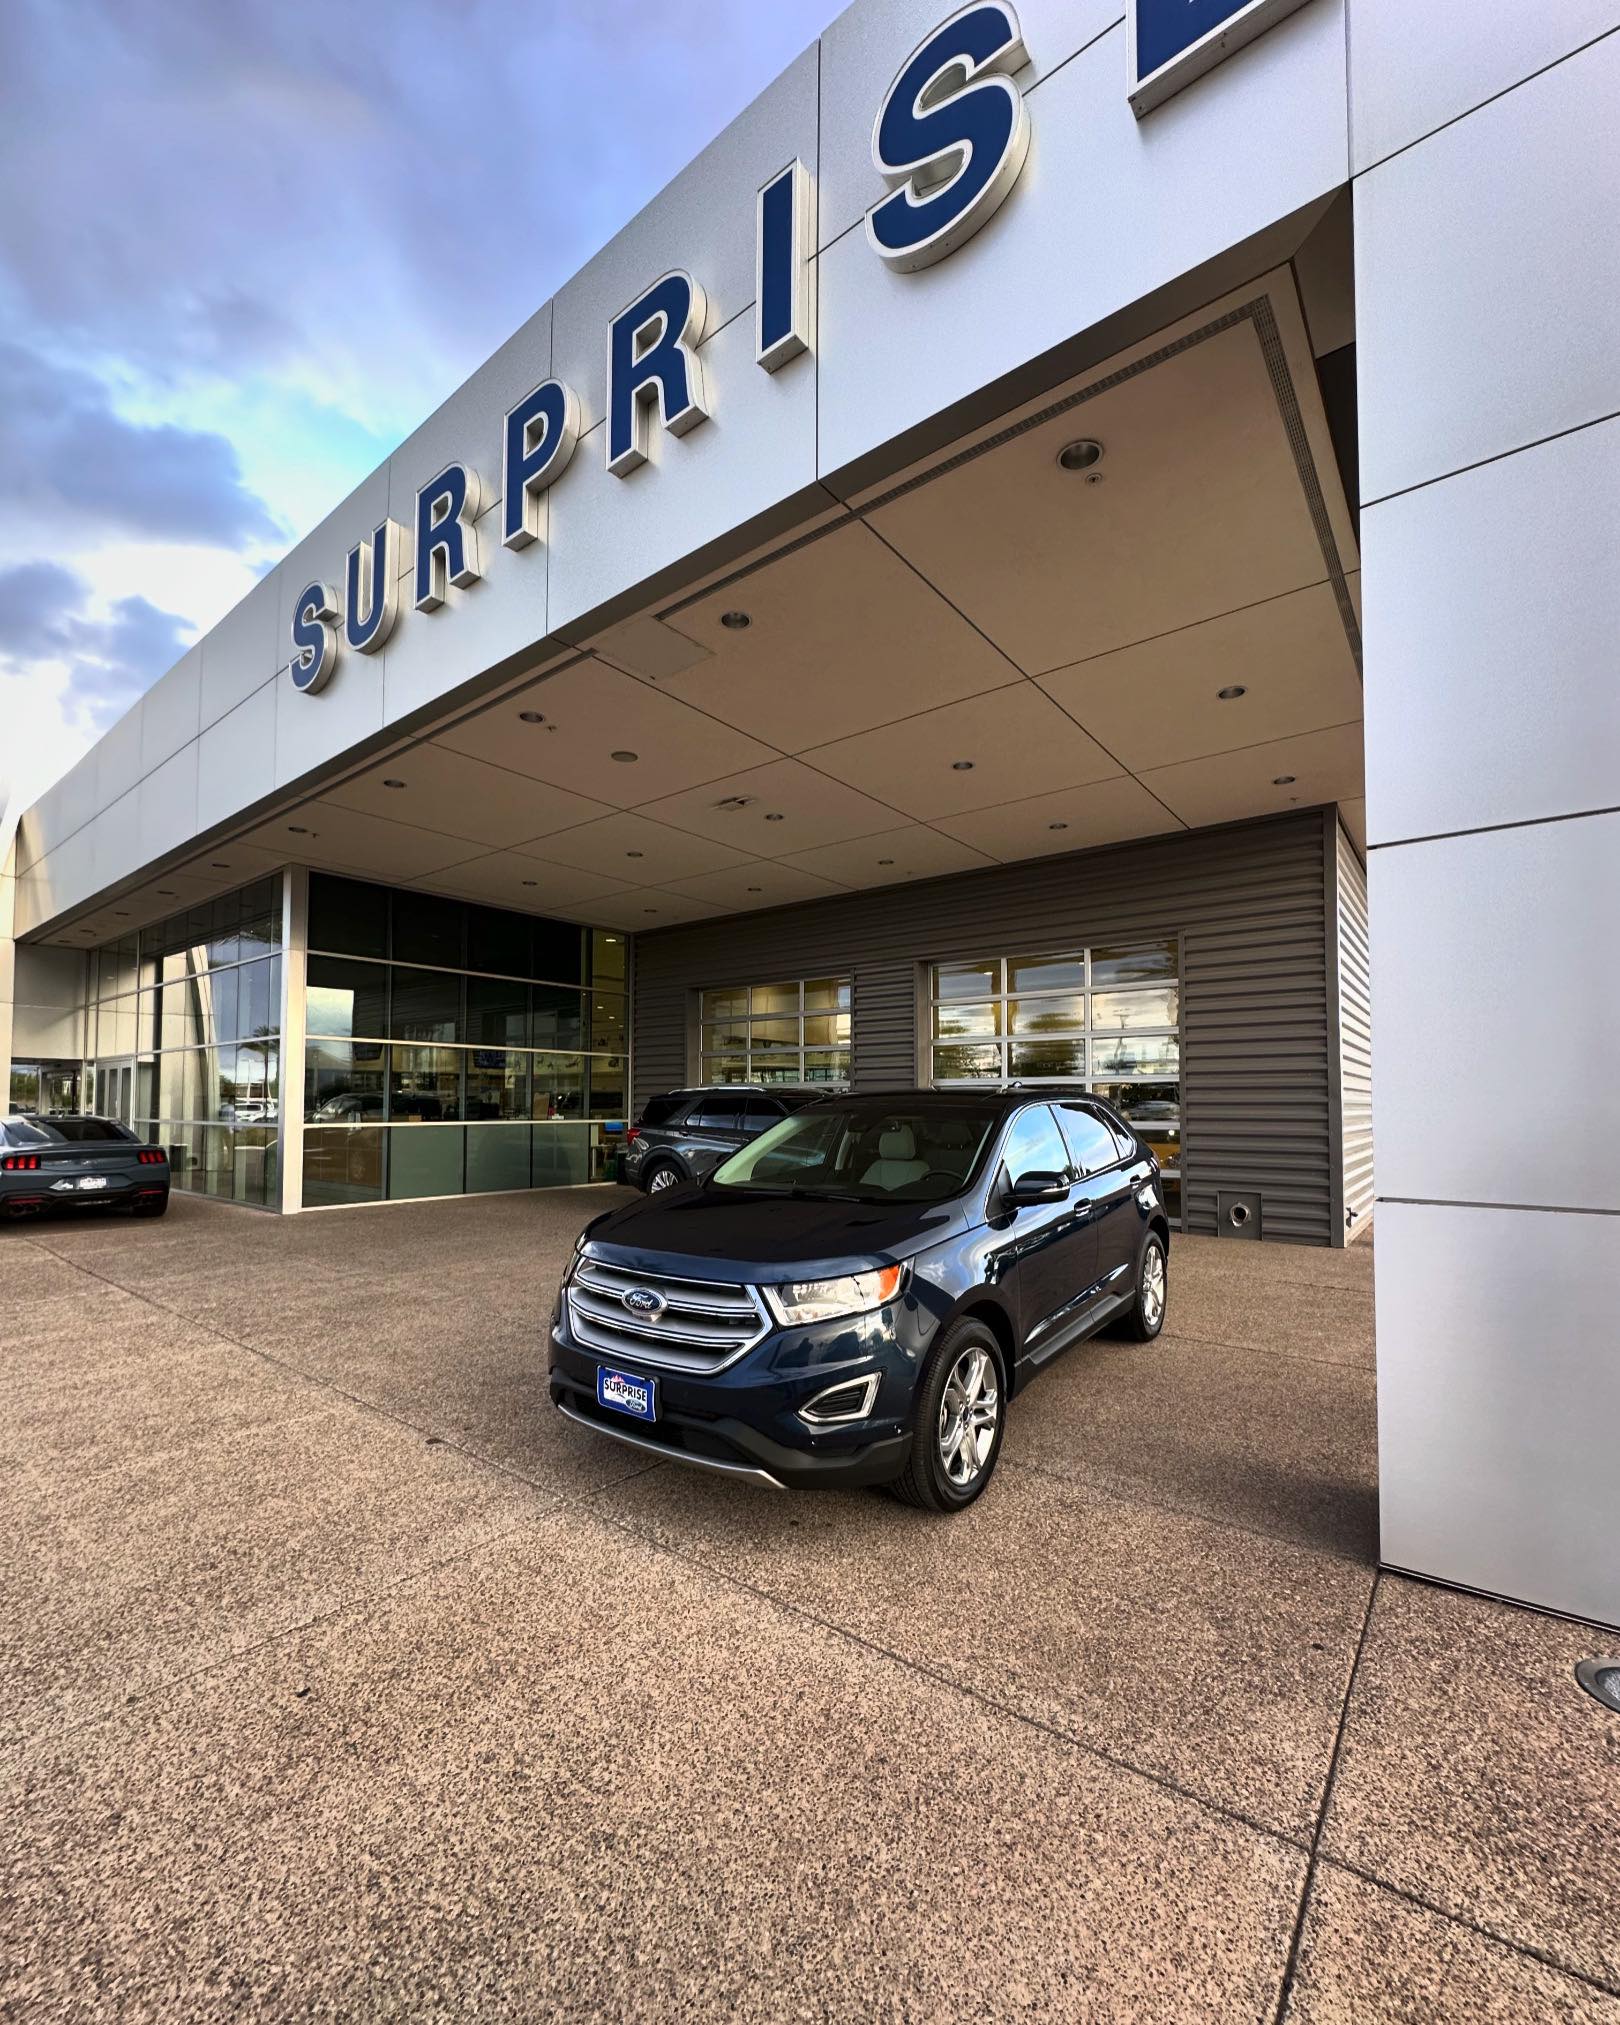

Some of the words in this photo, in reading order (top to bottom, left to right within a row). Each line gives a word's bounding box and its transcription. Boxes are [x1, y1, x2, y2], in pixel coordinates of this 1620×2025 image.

[289, 0, 1318, 694] SURPRIS
[629, 1291, 655, 1309] Ford
[604, 1379, 647, 1401] SURPRISE
[628, 1400, 644, 1411] Ford
